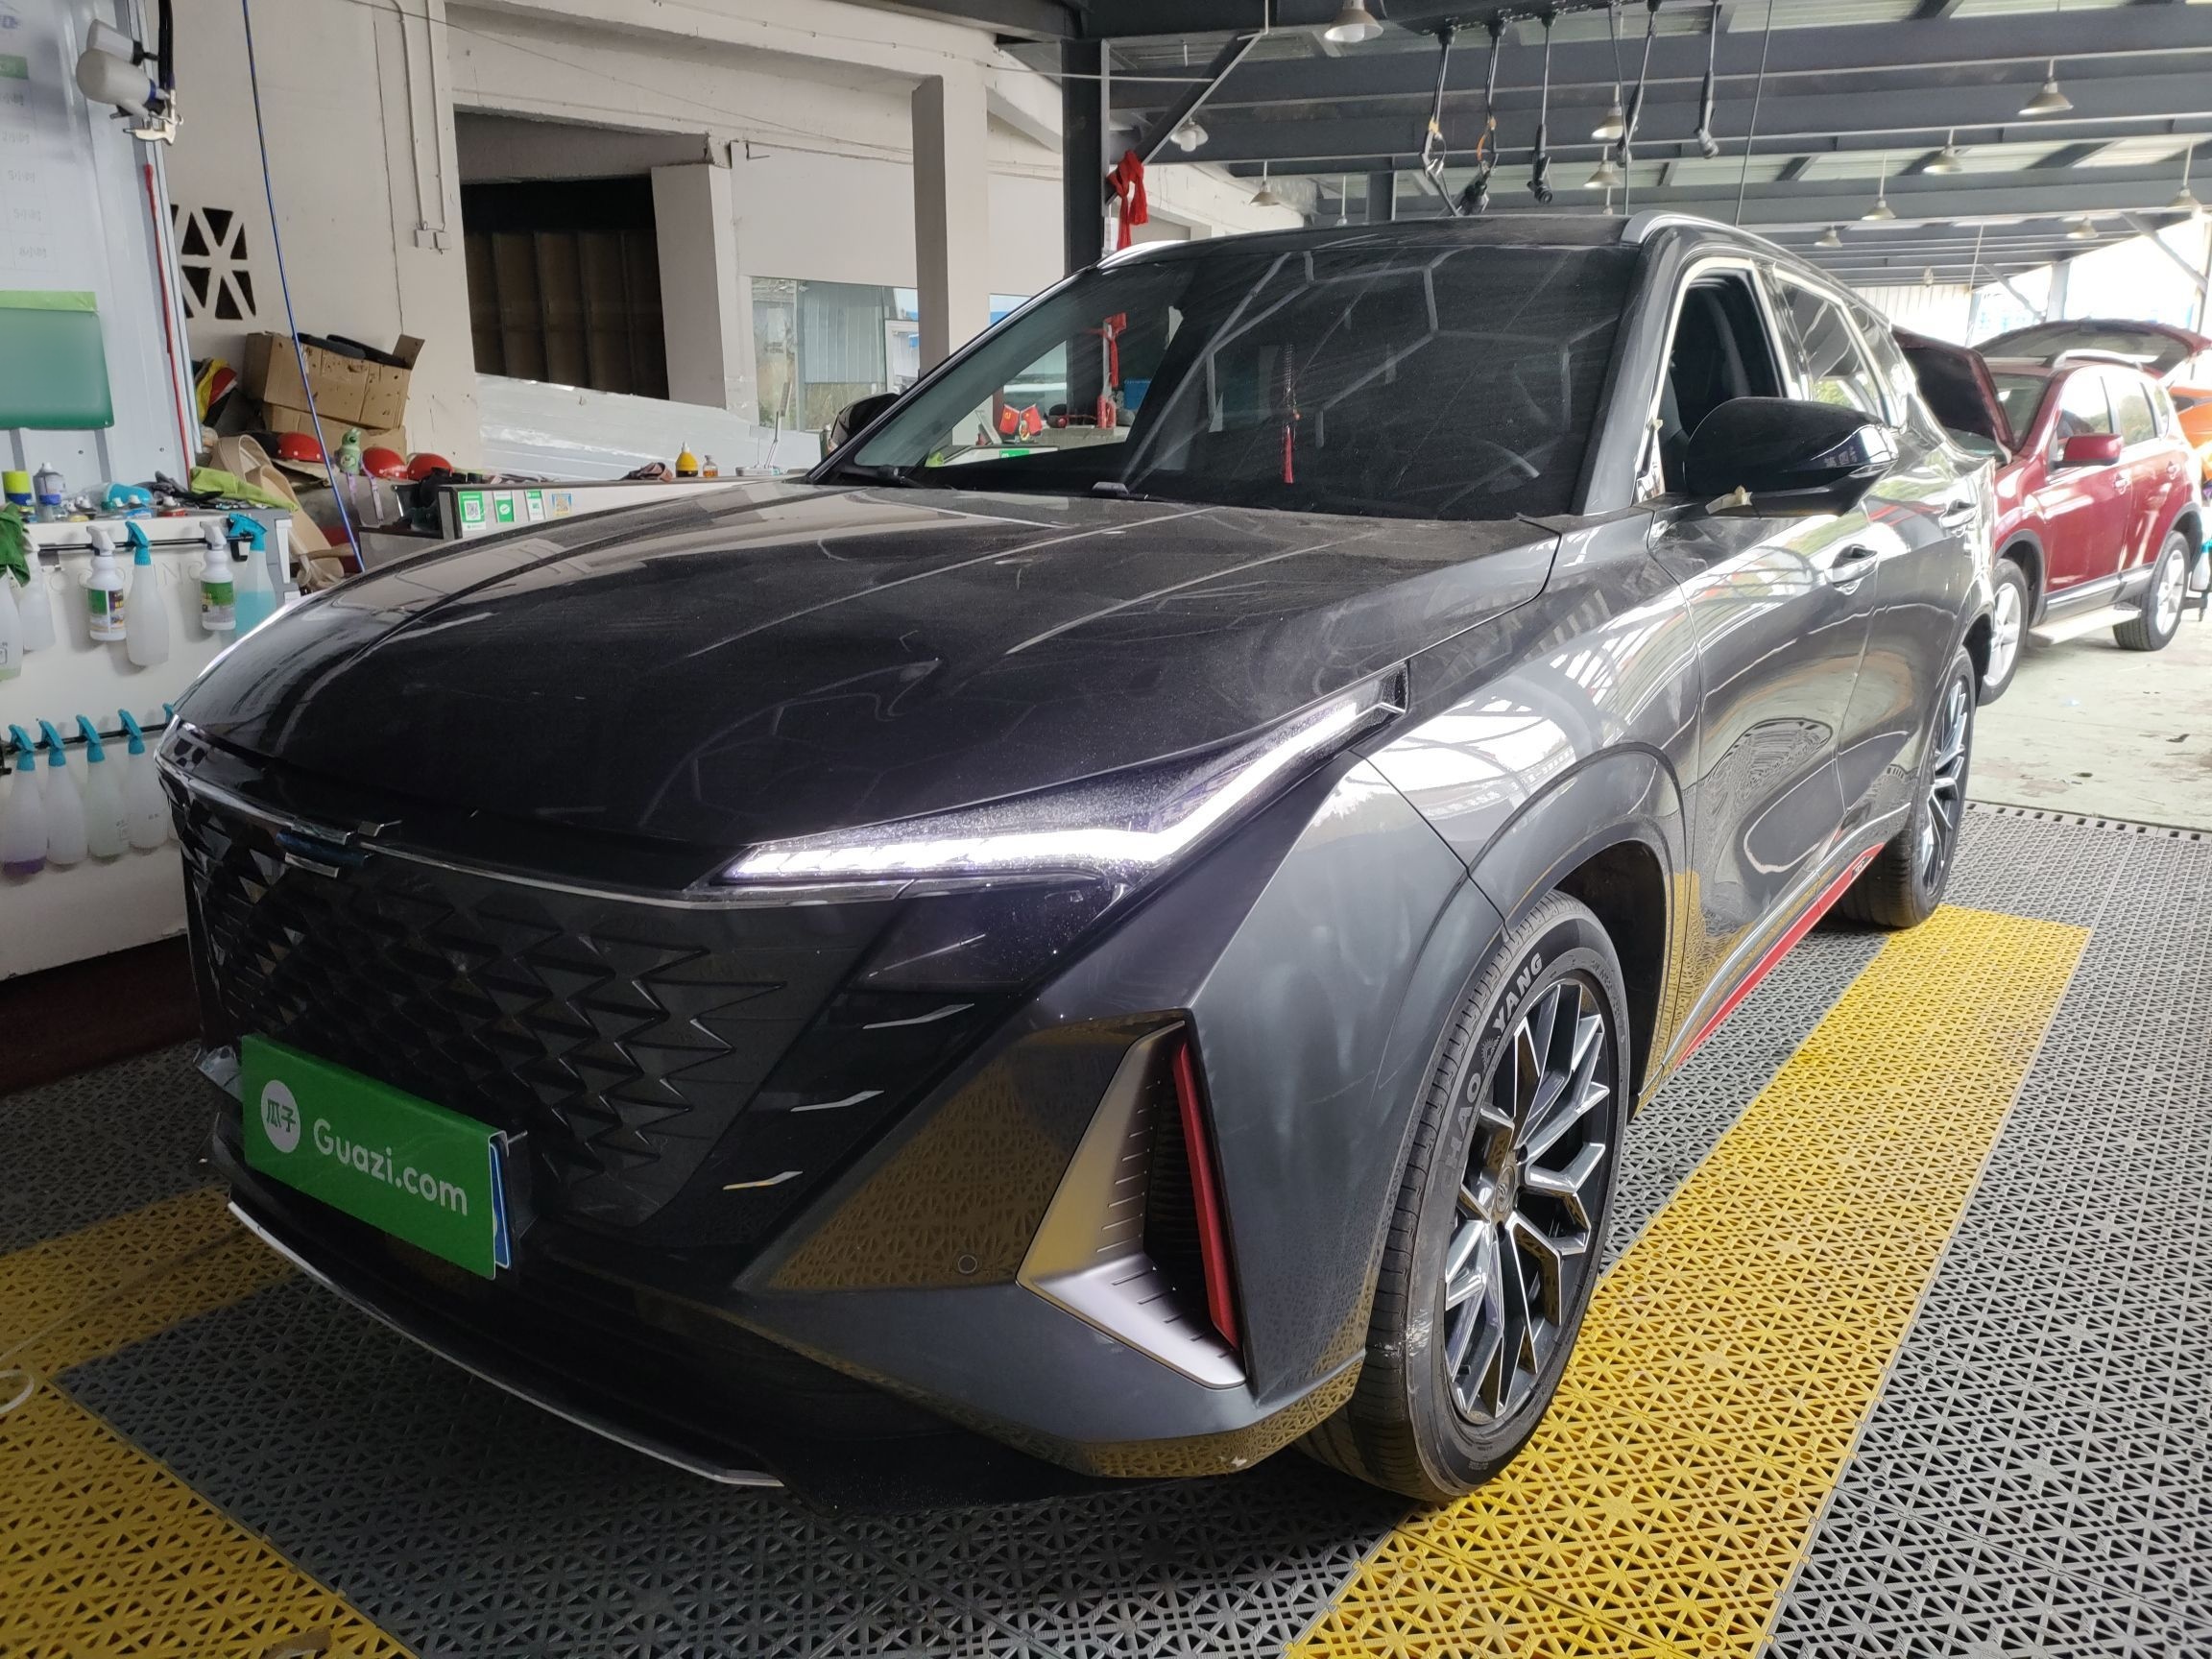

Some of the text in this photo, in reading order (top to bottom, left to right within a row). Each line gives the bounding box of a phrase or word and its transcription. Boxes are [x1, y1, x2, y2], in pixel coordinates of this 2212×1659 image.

[1491, 952, 1544, 1035] YANG
[266, 1097, 297, 1133] 瓜子
[313, 1118, 469, 1217] Guazi.com
